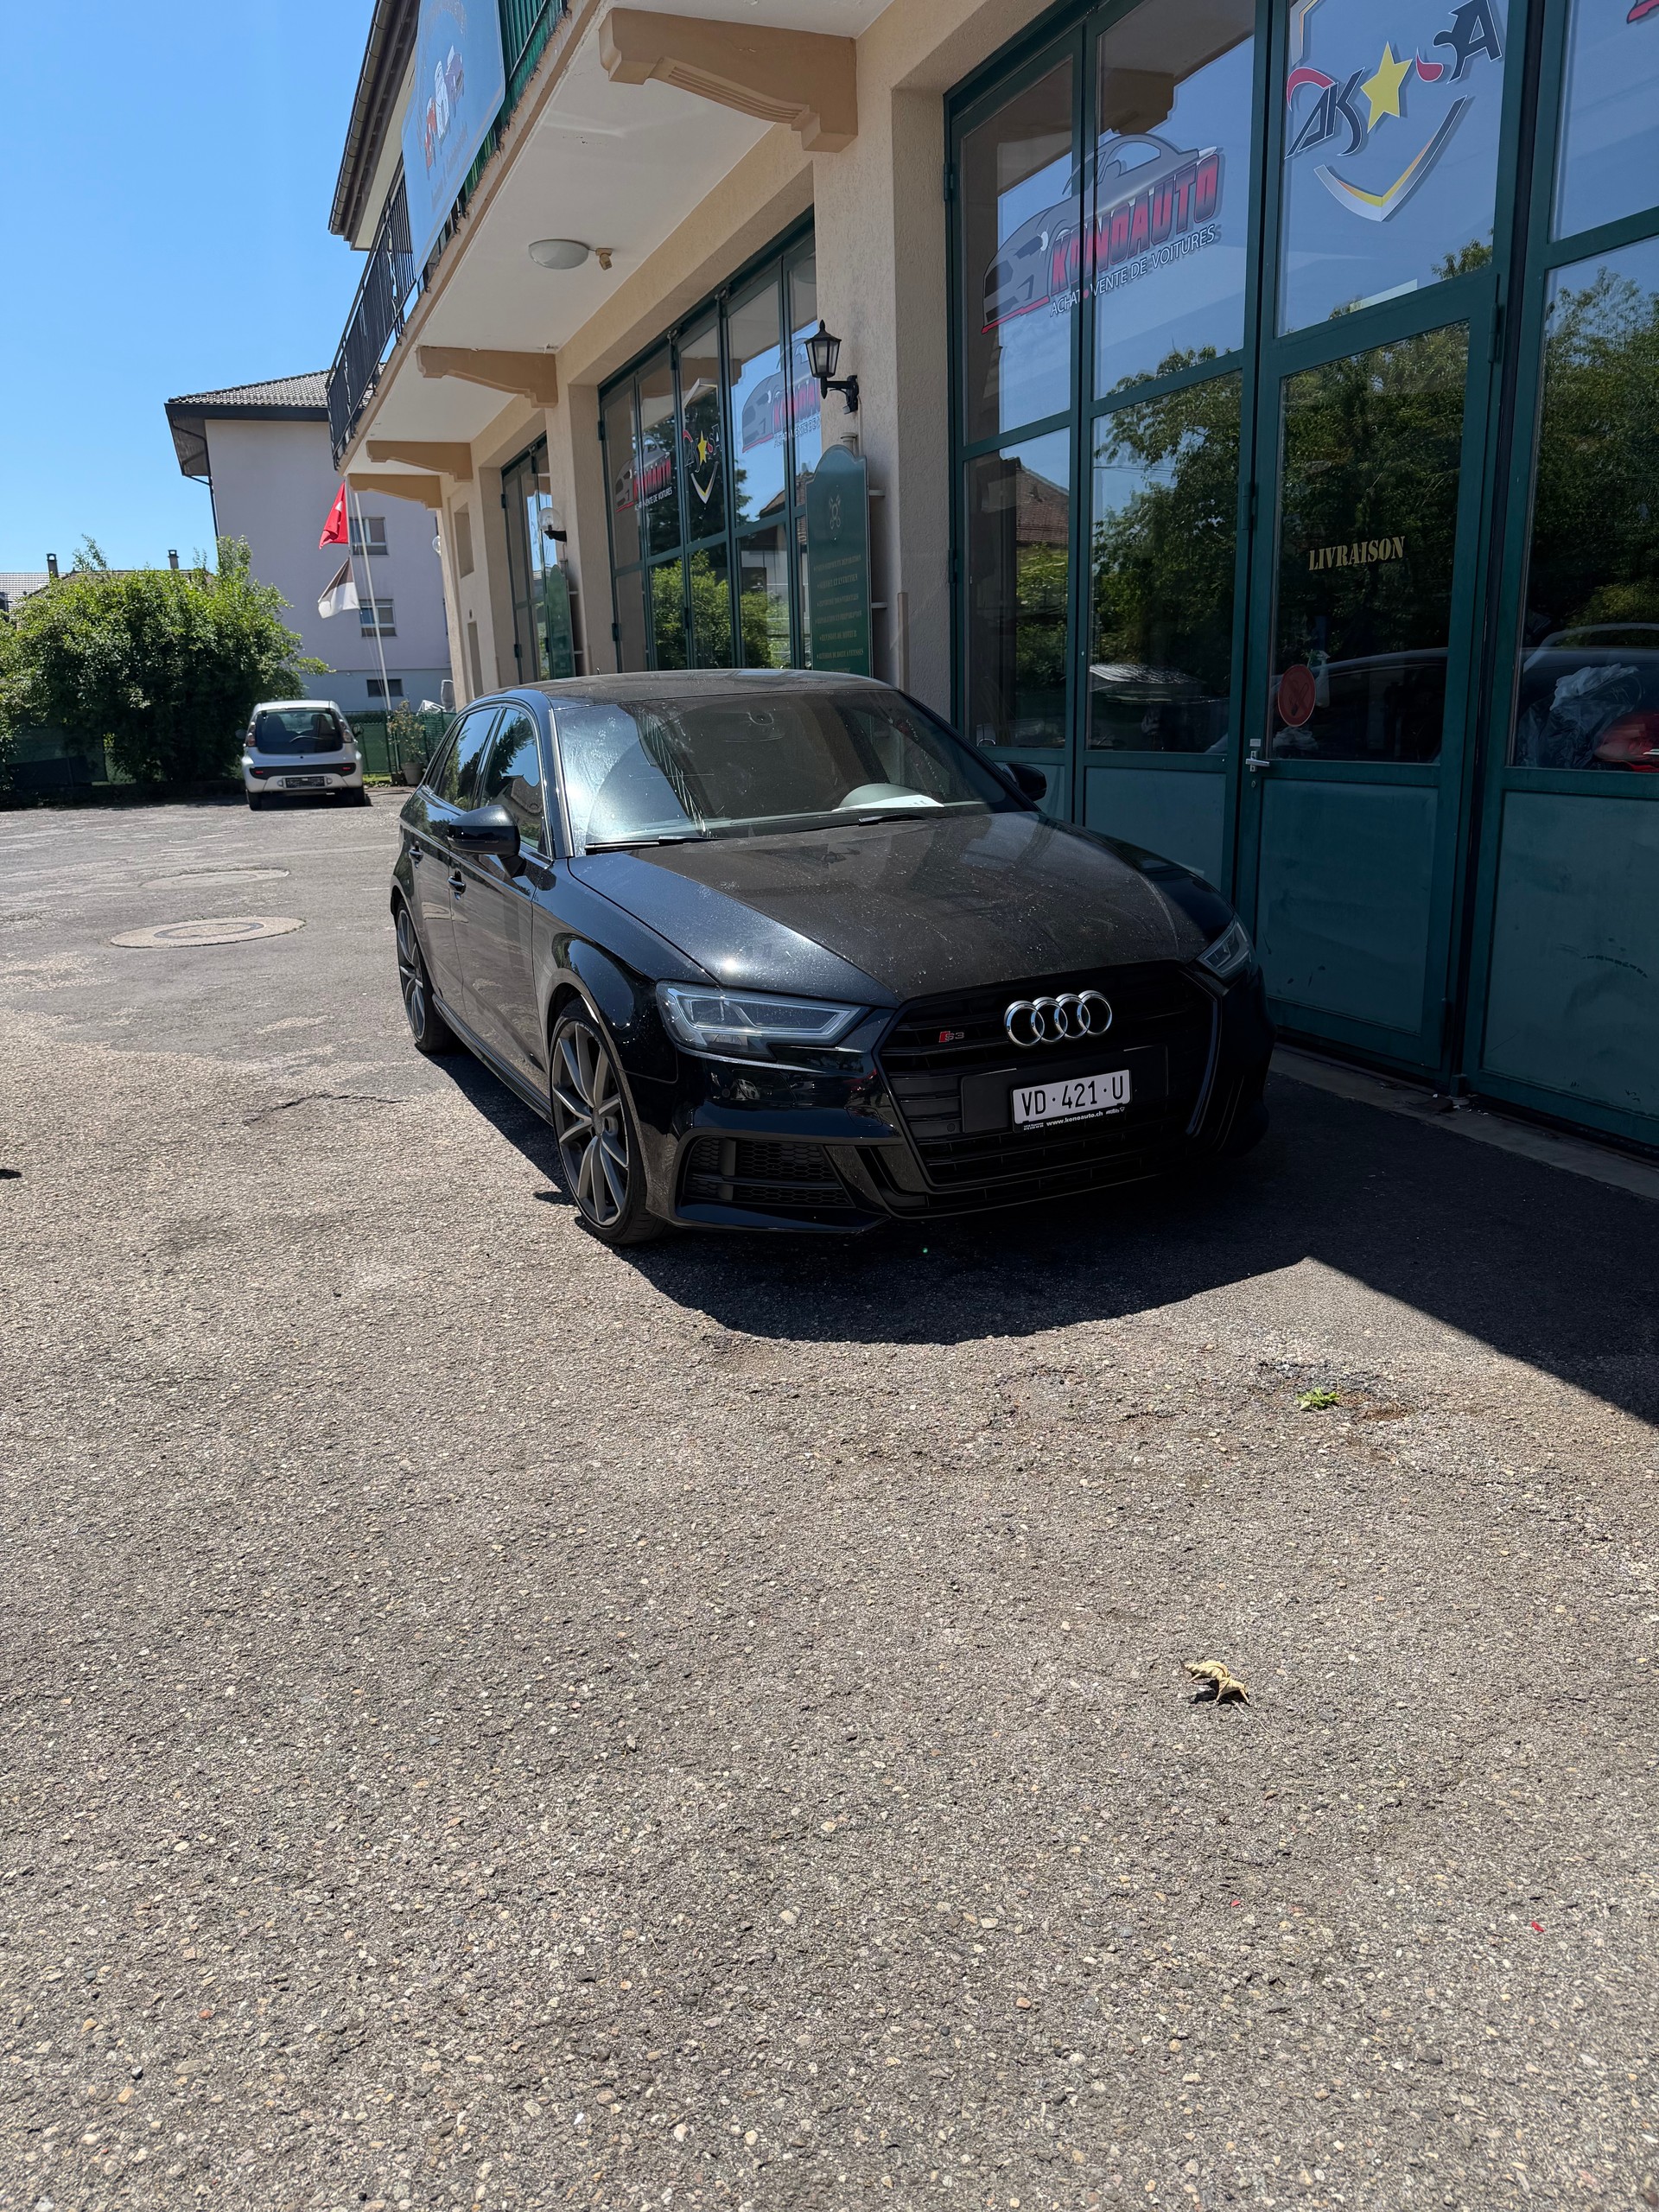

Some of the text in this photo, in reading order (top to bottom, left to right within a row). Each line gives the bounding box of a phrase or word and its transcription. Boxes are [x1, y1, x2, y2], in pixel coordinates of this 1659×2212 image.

[1051, 154, 1219, 296] KONOAUTO
[1050, 225, 1215, 318] ACHAT VENTE DE VOITURES
[1308, 536, 1406, 570] LIVRAISON
[1021, 1076, 1123, 1116] VD 421 U
[1046, 1112, 1103, 1127] www.konoauto.ch
